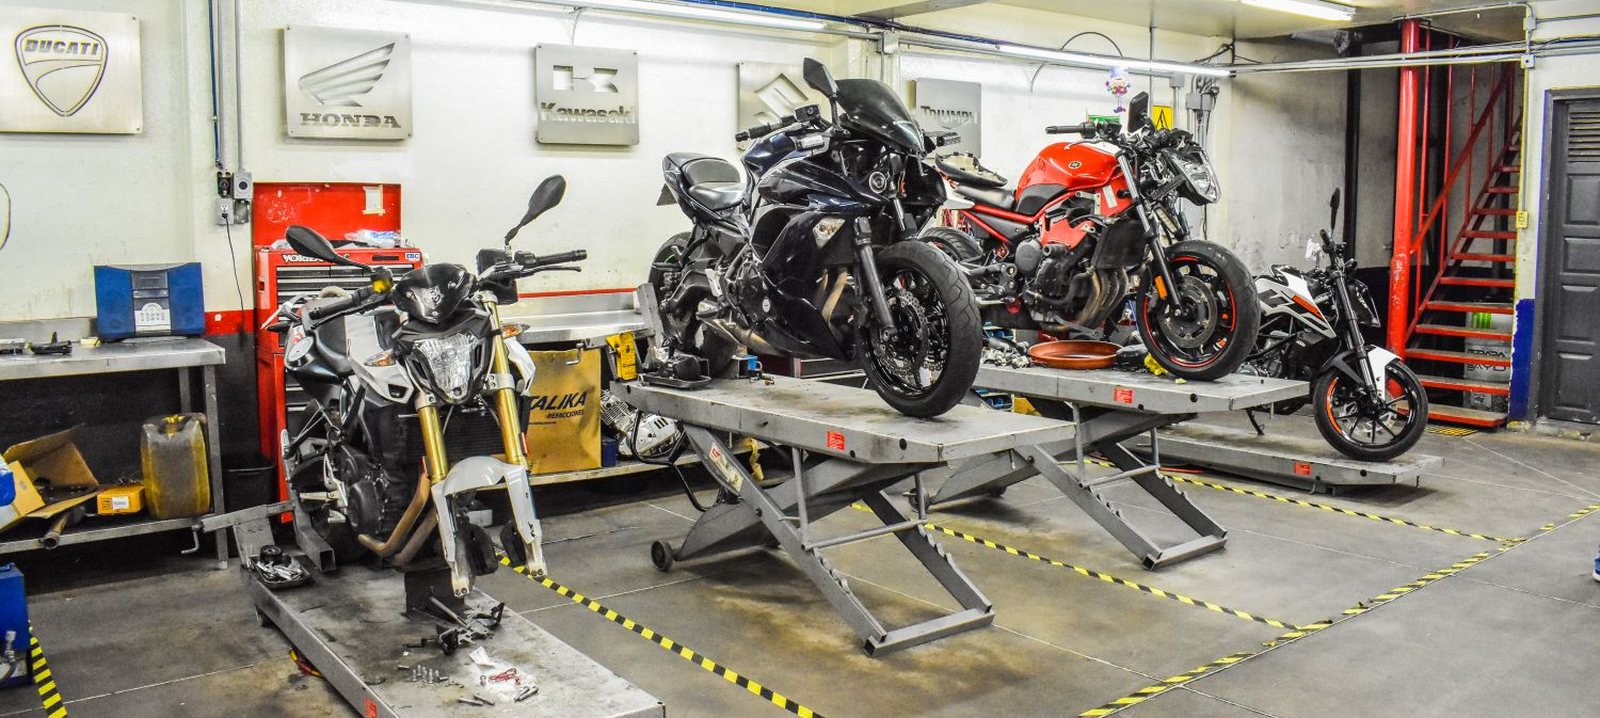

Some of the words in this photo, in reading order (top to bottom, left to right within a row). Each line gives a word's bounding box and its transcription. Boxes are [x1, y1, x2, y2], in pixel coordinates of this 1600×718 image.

[24, 39, 99, 55] DUCATI
[300, 113, 401, 128] HONDA
[541, 102, 636, 124] Kawasaki
[920, 105, 978, 124] TRIUMPH
